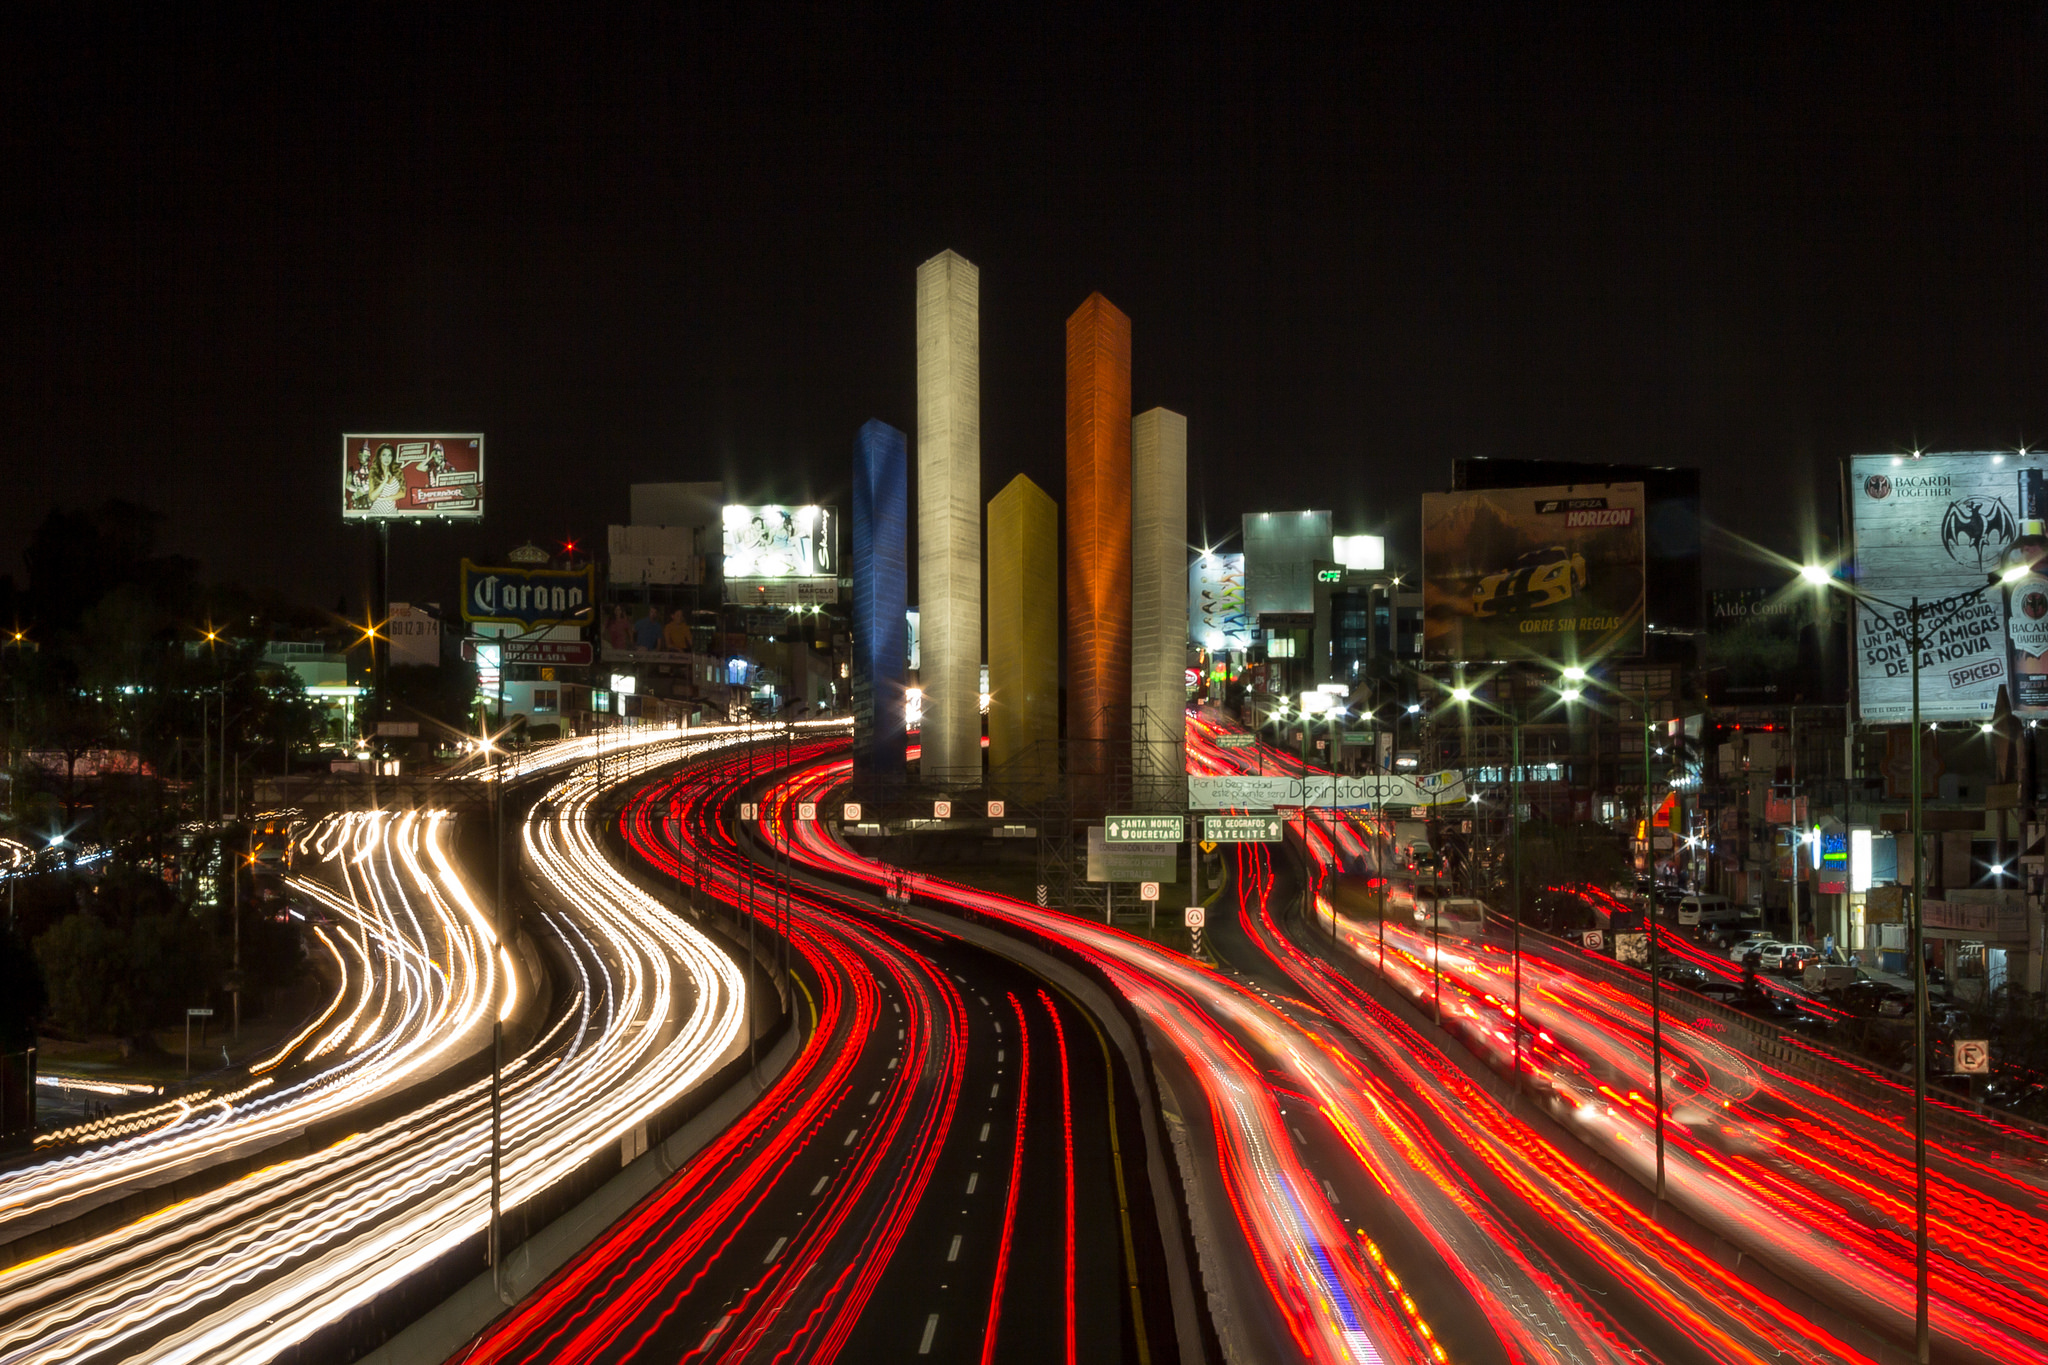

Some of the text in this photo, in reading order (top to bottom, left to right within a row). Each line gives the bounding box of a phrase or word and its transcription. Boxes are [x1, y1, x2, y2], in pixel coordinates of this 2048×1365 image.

[1896, 488, 1952, 497] TOGETHER
[1568, 499, 1602, 508] FORZA
[1567, 509, 1631, 527] HORIZON
[1317, 569, 1341, 583] CFE
[474, 575, 583, 615] Corona
[1714, 601, 1788, 616] Aldo Conti
[1863, 616, 1889, 635] LO
[1961, 591, 1988, 607] DE
[1519, 617, 1620, 633] CORRE SIN REGLAS
[1862, 636, 1881, 648] UN
[1885, 624, 1925, 643] AMIGO
[1928, 616, 1953, 630] CON
[1866, 643, 1901, 666] SON
[1939, 616, 2000, 646] AMIGAS
[1884, 658, 1910, 678] DE
[1938, 636, 1992, 663] NOVIA
[1952, 662, 2001, 686] SPICED
[1193, 779, 1209, 789] Por
[1213, 779, 1223, 788] tu
[1289, 776, 1403, 799] Desinstalado
[1211, 790, 1229, 798] este
[1121, 819, 1180, 828] SANTA MONICA
[1208, 819, 1266, 828] CTO. GEOGRAFOS
[1130, 830, 1181, 839] QUERETARO
[1207, 830, 1266, 839] SATELITE
[1964, 1048, 1977, 1065] E
